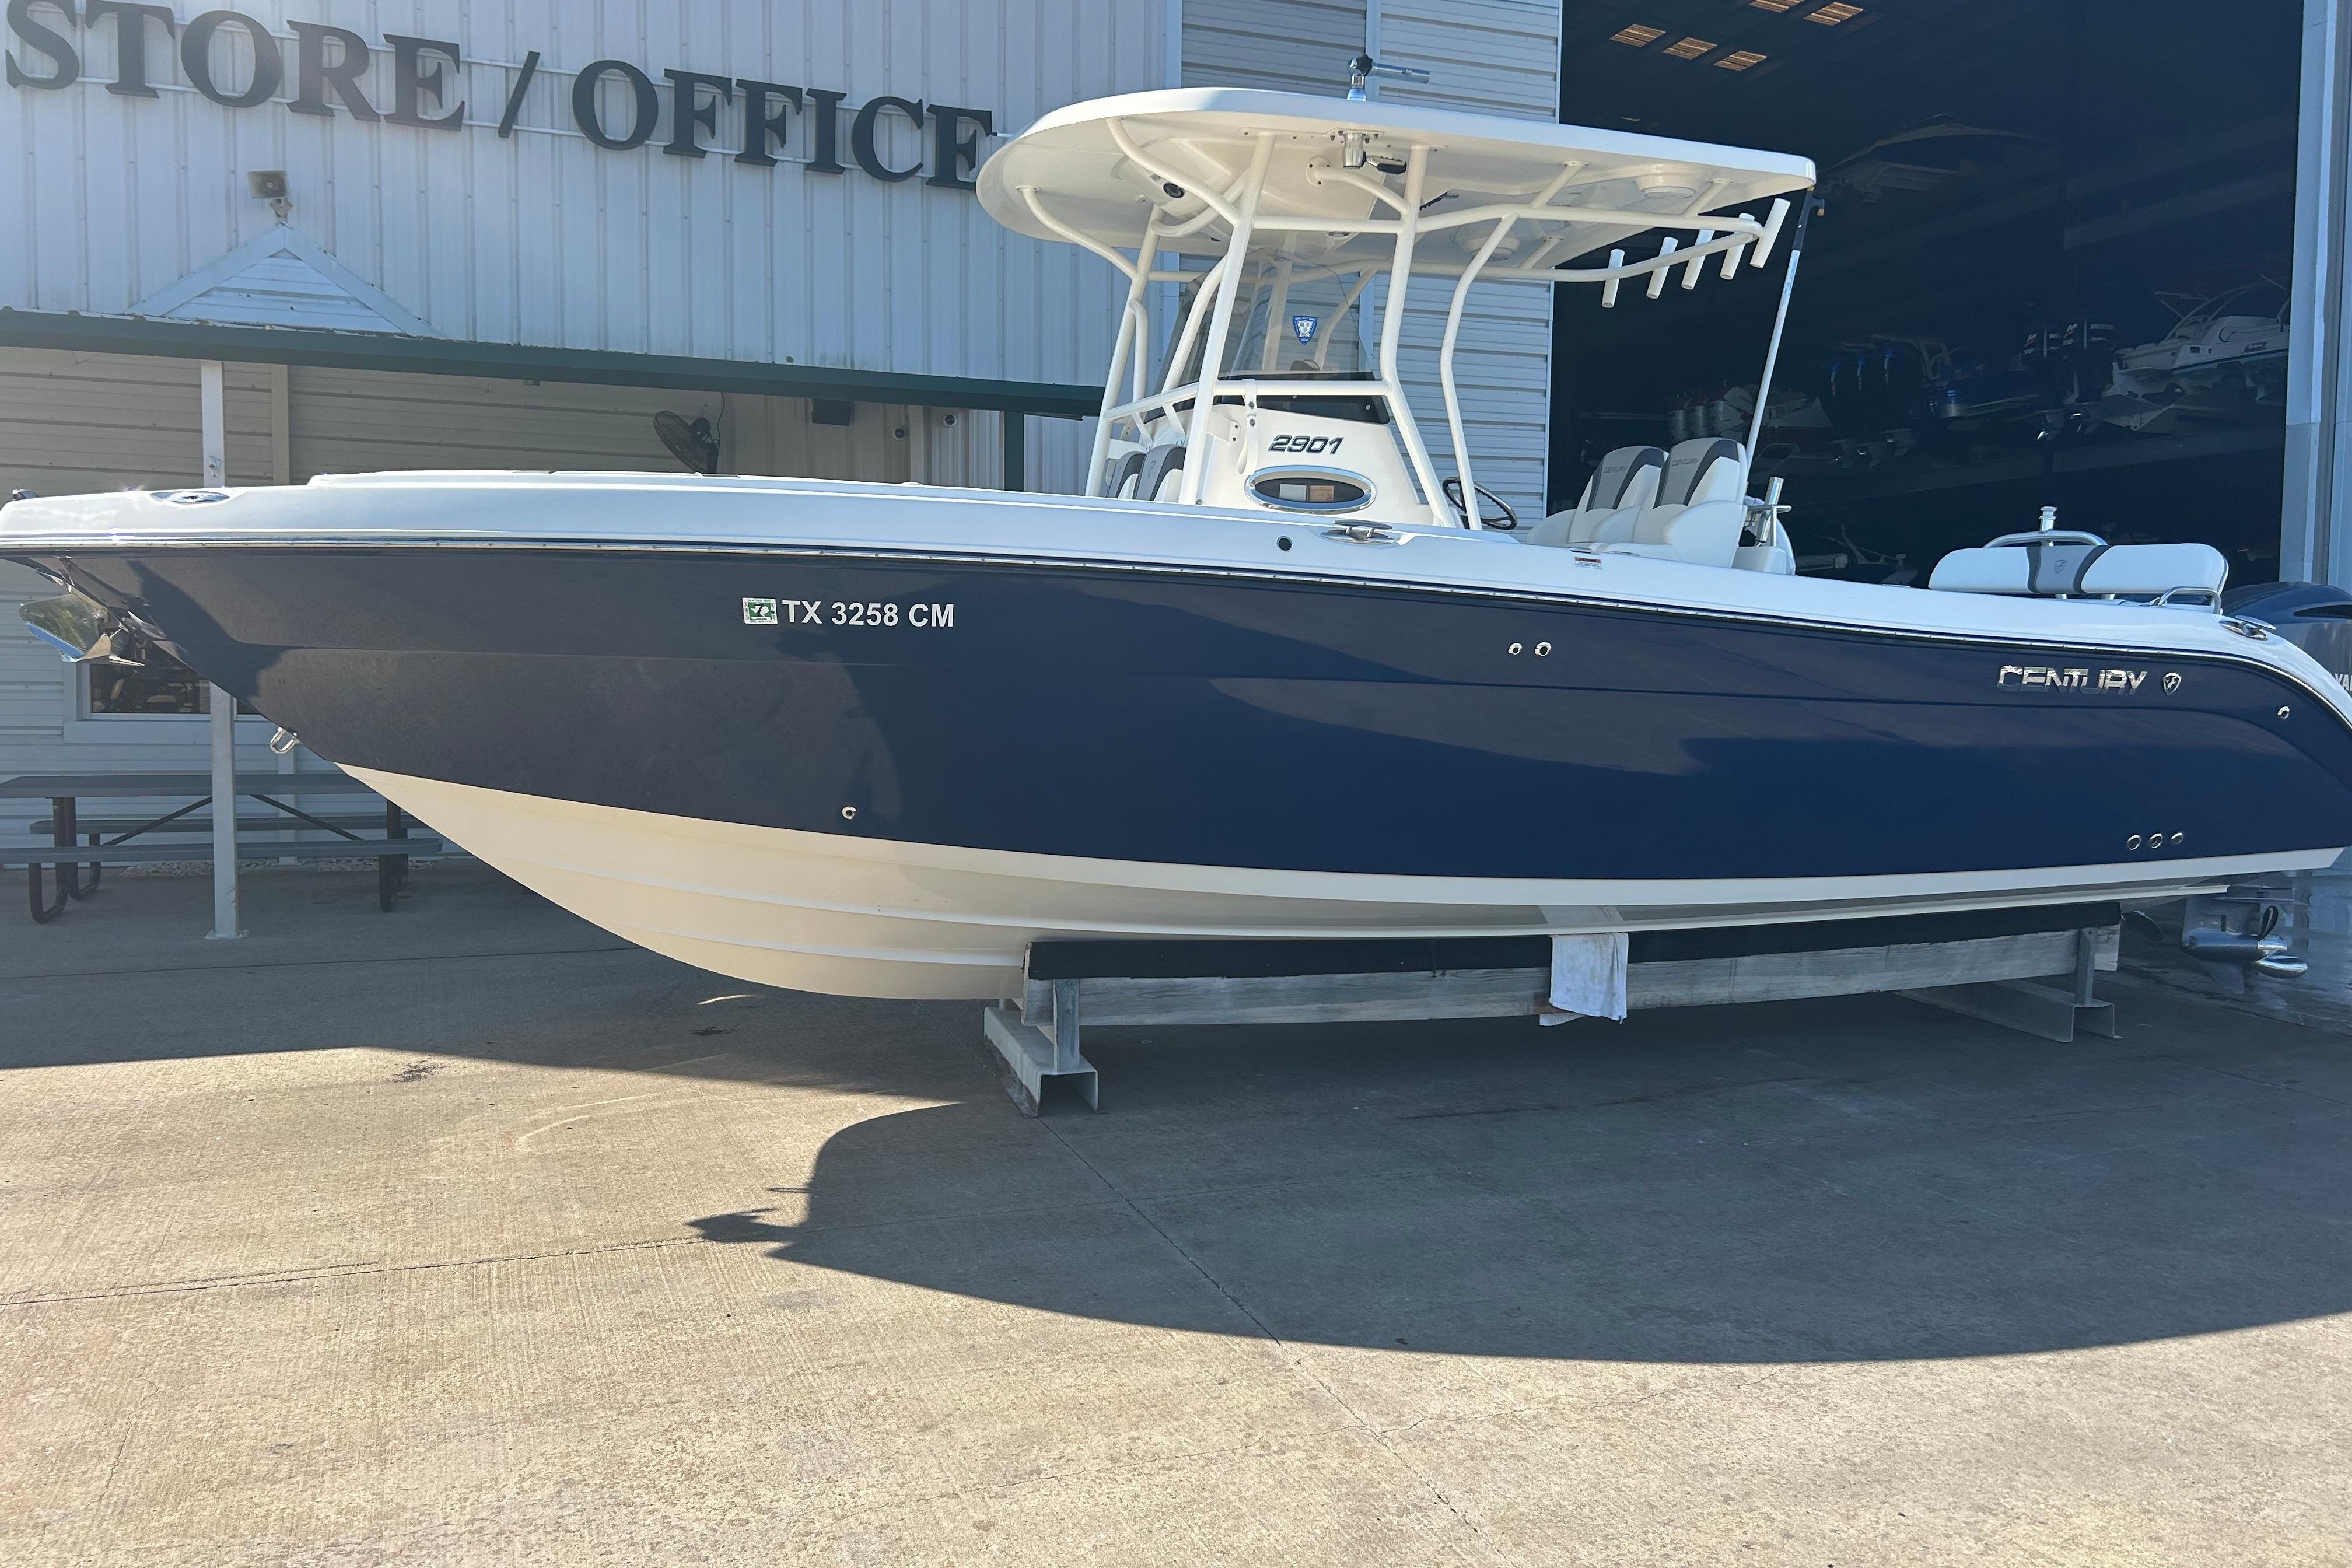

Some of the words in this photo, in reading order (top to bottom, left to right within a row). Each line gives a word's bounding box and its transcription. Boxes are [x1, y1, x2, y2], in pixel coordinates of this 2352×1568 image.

[5, 0, 466, 132] STORE
[497, 50, 541, 139] /
[572, 60, 993, 191] OFFICE
[1268, 435, 1344, 454] 2901
[782, 600, 822, 624] TX
[831, 601, 898, 627] 3258
[909, 603, 954, 627] CM
[1996, 665, 2147, 695] CENTURY
[2334, 673, 2352, 691] YA
